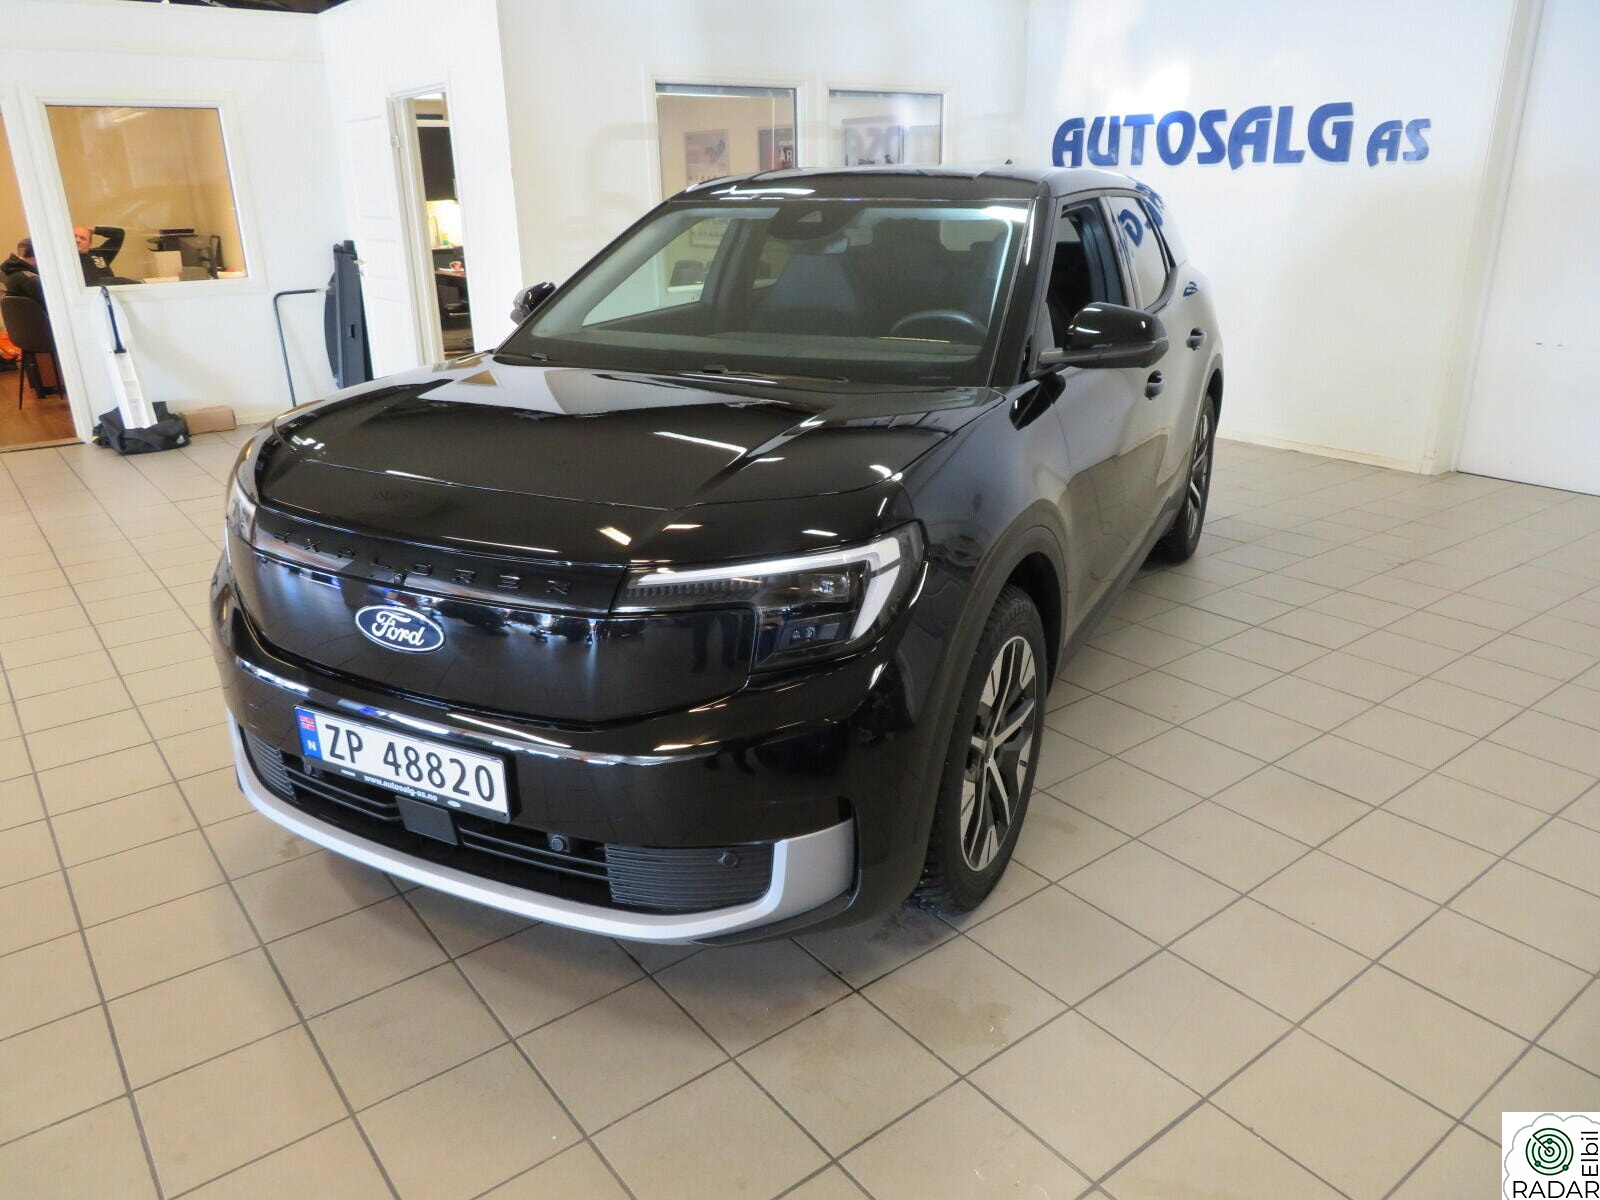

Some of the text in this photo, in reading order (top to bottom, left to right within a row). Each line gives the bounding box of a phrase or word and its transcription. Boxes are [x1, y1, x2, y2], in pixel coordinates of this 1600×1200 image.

[1052, 102, 1431, 170] AUTOSALG AS
[371, 609, 425, 647] Ford
[307, 739, 317, 752] N
[325, 723, 495, 802] ZP 48820
[363, 775, 438, 802] www.autosalg-as.no
